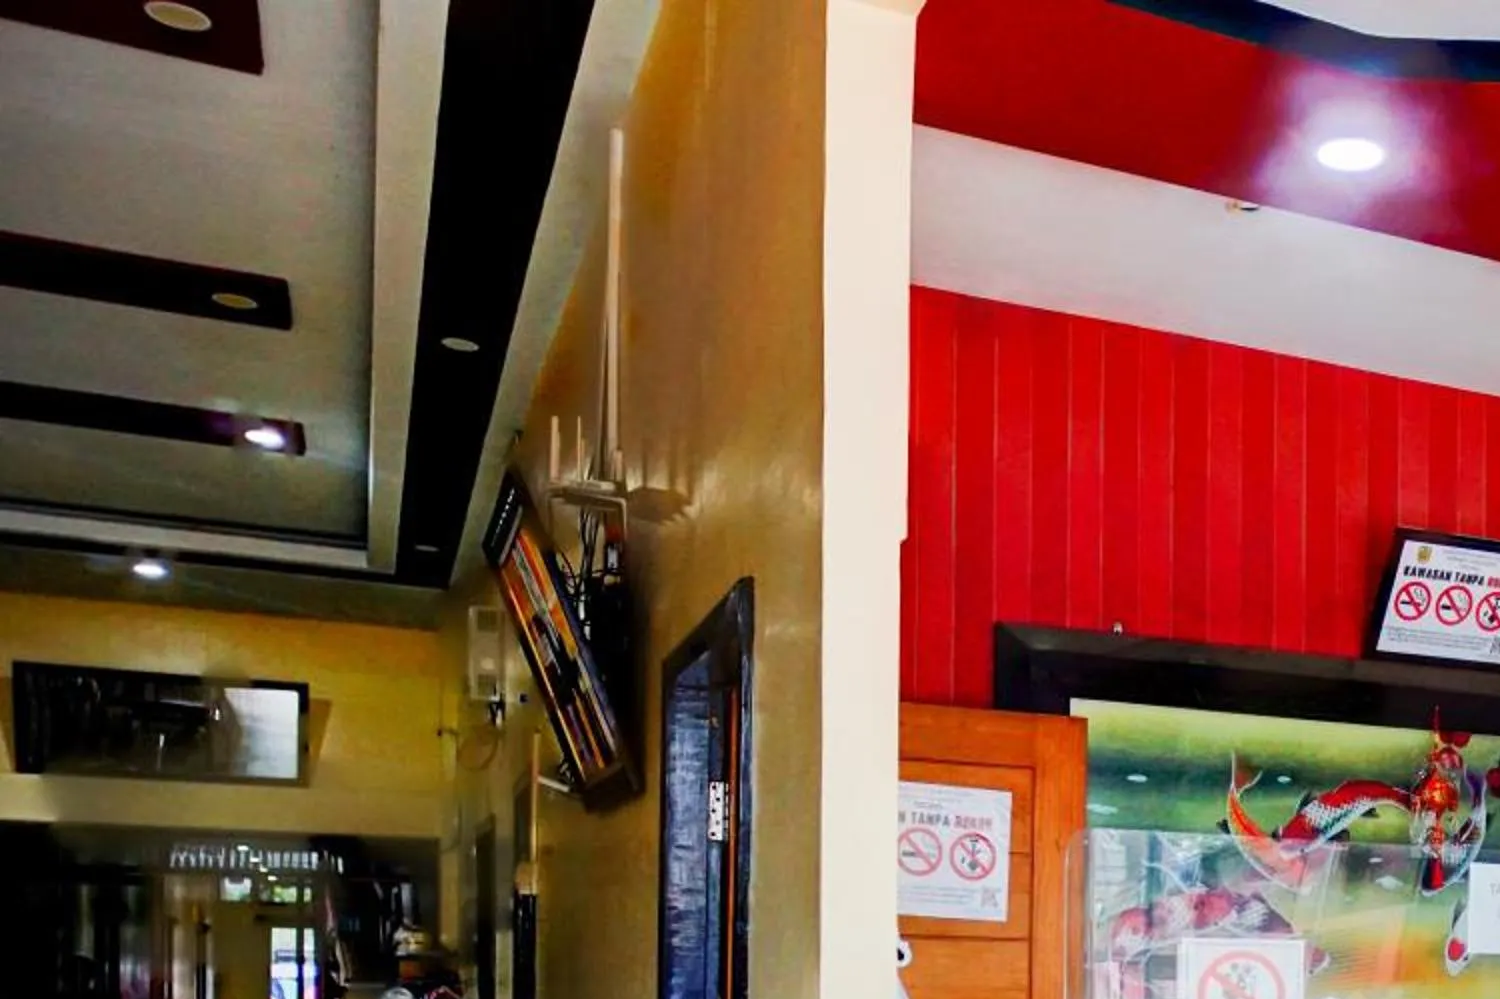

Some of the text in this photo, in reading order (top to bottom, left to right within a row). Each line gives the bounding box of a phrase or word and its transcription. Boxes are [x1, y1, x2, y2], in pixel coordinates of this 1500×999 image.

[1403, 565, 1452, 582] KAWASAN
[1453, 572, 1485, 586] TANPA
[911, 811, 950, 827] TANPA
